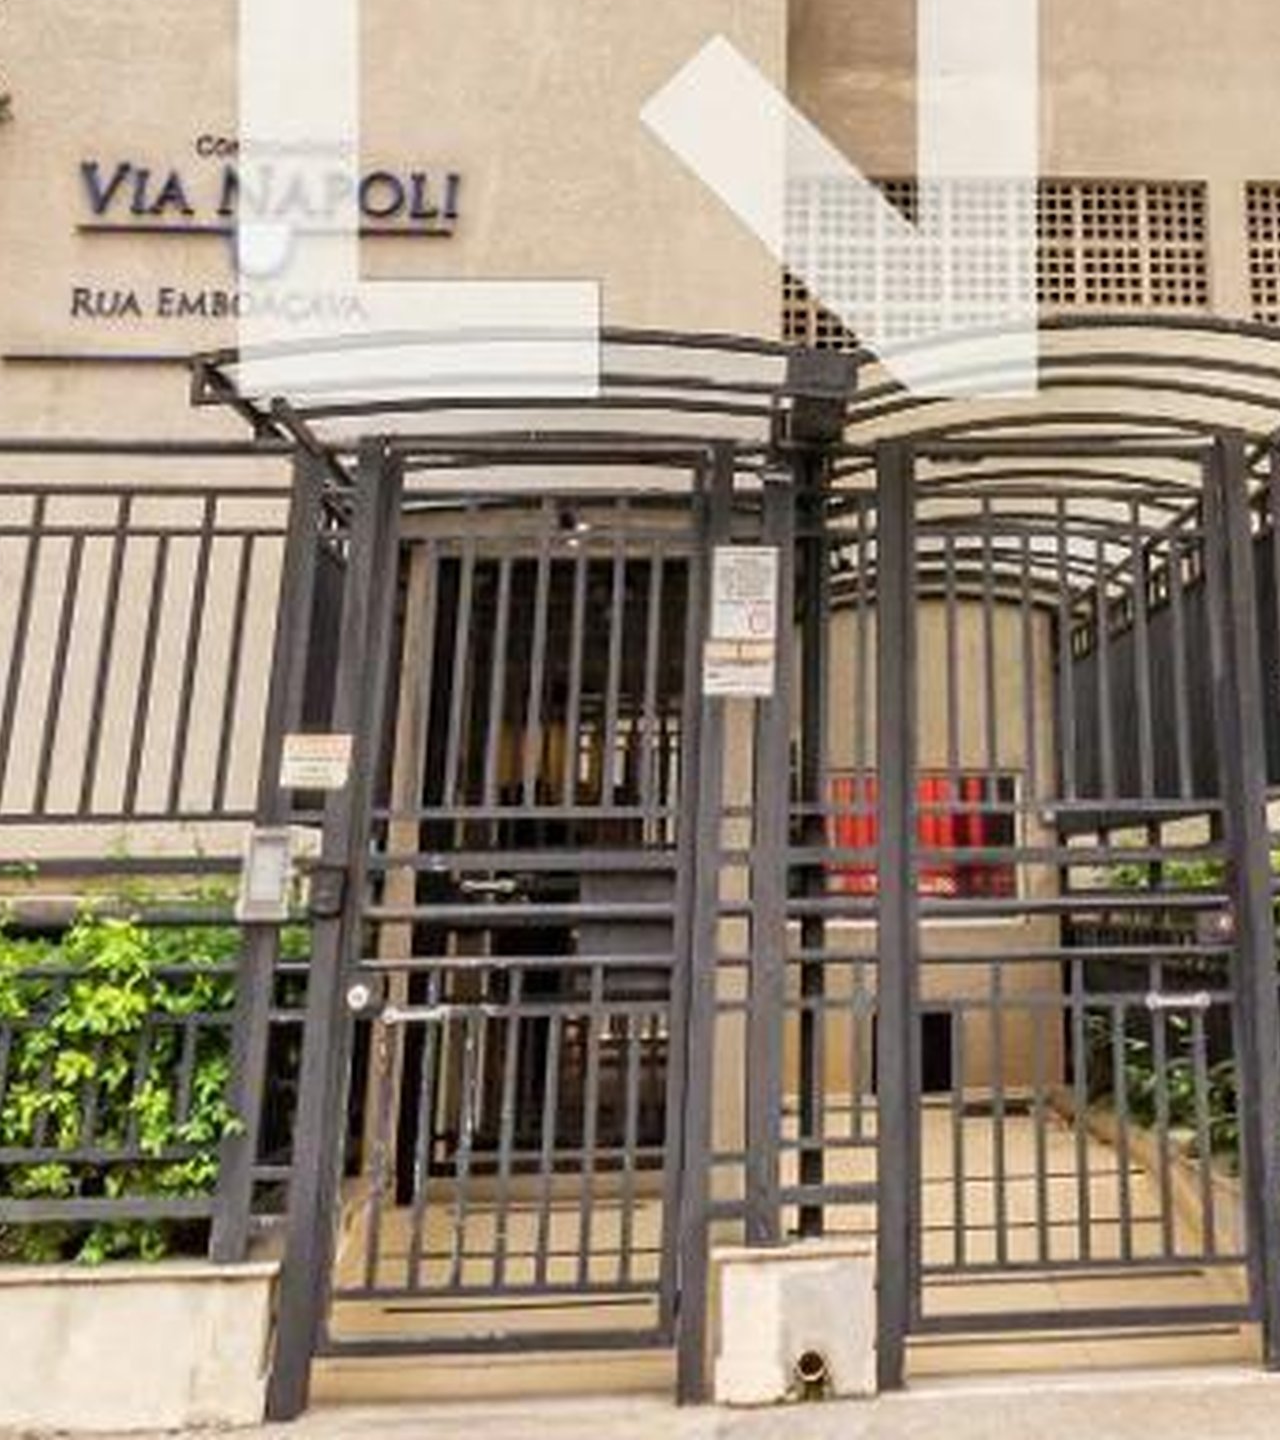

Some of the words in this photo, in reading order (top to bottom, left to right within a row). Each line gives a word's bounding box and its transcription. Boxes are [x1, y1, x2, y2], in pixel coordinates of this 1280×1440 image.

[79, 161, 194, 217] VIA
[217, 164, 462, 221] NAPOLI
[71, 288, 141, 319] RUA
